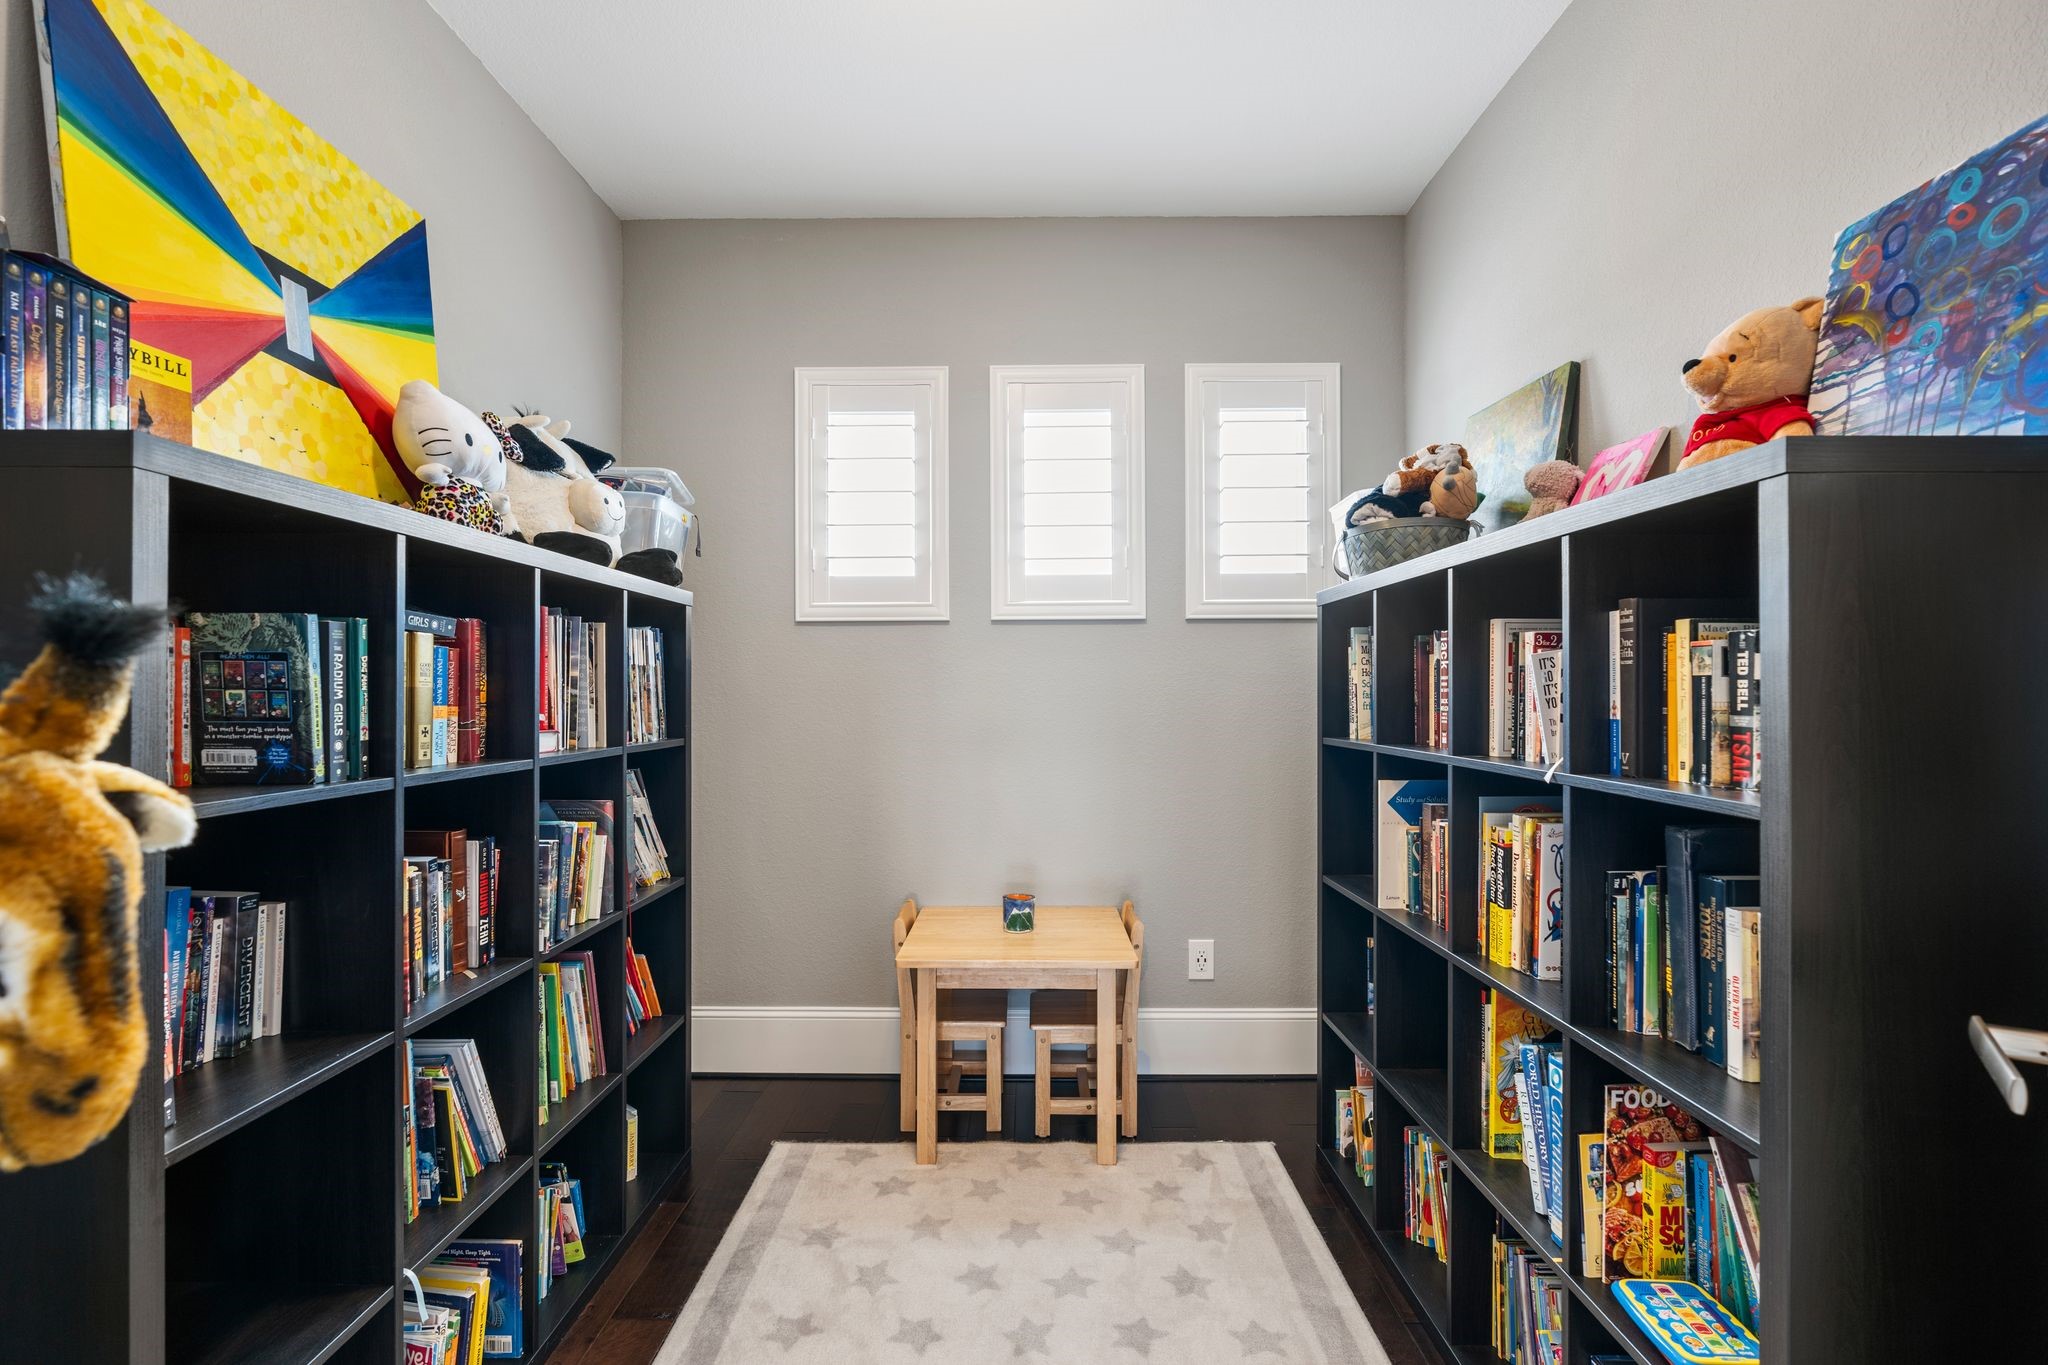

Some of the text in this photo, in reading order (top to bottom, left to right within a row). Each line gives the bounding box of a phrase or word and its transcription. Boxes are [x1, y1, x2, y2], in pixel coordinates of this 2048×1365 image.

[11, 291, 19, 310] KIM
[55, 305, 64, 319] LEE
[10, 315, 19, 331] THE
[10, 334, 19, 352] LAST
[55, 348, 65, 366] and
[408, 615, 430, 628] GIRLS
[1702, 624, 1738, 632] Maeve
[1536, 635, 1543, 646] 3
[1550, 635, 1557, 646] 2
[1538, 656, 1556, 670] IT'S
[1736, 650, 1748, 711] TED BELL
[333, 653, 344, 736] RADIUM GIRLS
[1732, 731, 1752, 782] TSAR
[1395, 795, 1416, 805] Study
[479, 872, 488, 917] GROUND
[1496, 846, 1505, 908] Basketball
[413, 907, 423, 960] MINRS
[430, 893, 440, 965] DIVERGENT
[479, 917, 488, 946] ZERO
[1699, 902, 1712, 960] JOKES
[172, 949, 181, 985] AVIATION
[239, 936, 254, 1026] DIVERGENT
[1710, 959, 1716, 972] OF
[170, 985, 179, 1019] THERAPY
[1731, 975, 1740, 1029] OLIVER TWIST
[1526, 1050, 1549, 1164] WORLD HISTORY
[1520, 1090, 1540, 1201] RED QUEEN
[1551, 1095, 1562, 1198] Calculus
